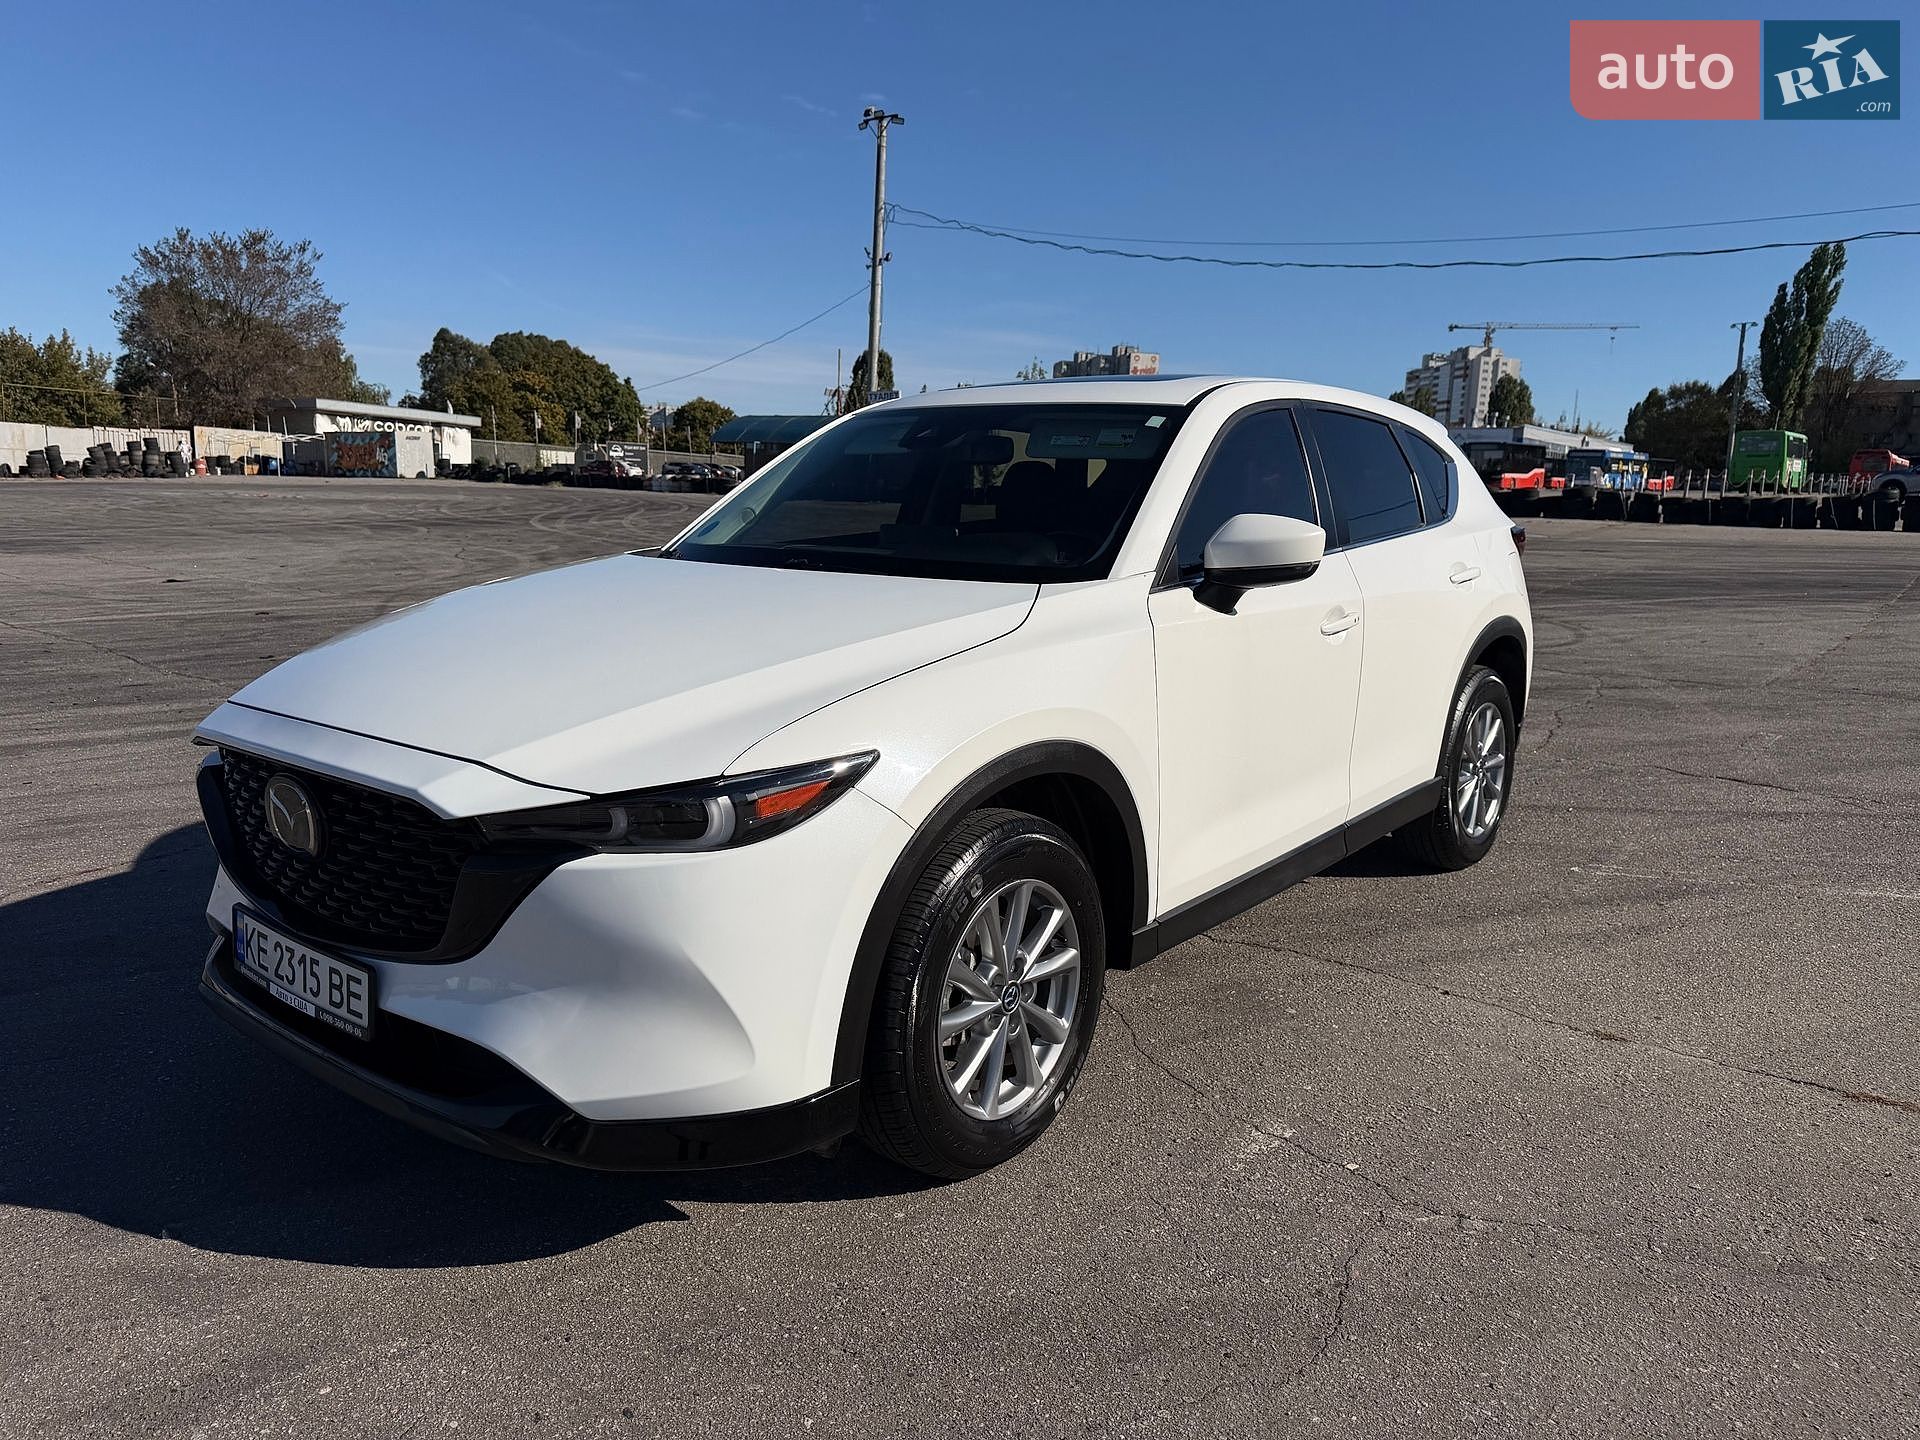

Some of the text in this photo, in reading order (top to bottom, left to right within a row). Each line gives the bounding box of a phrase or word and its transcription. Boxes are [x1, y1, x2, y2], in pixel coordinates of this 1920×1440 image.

[244, 922, 269, 973] KE
[273, 940, 321, 999] 2315
[328, 966, 364, 1020] BE
[274, 987, 289, 1002] Авто
[293, 997, 308, 1013] США
